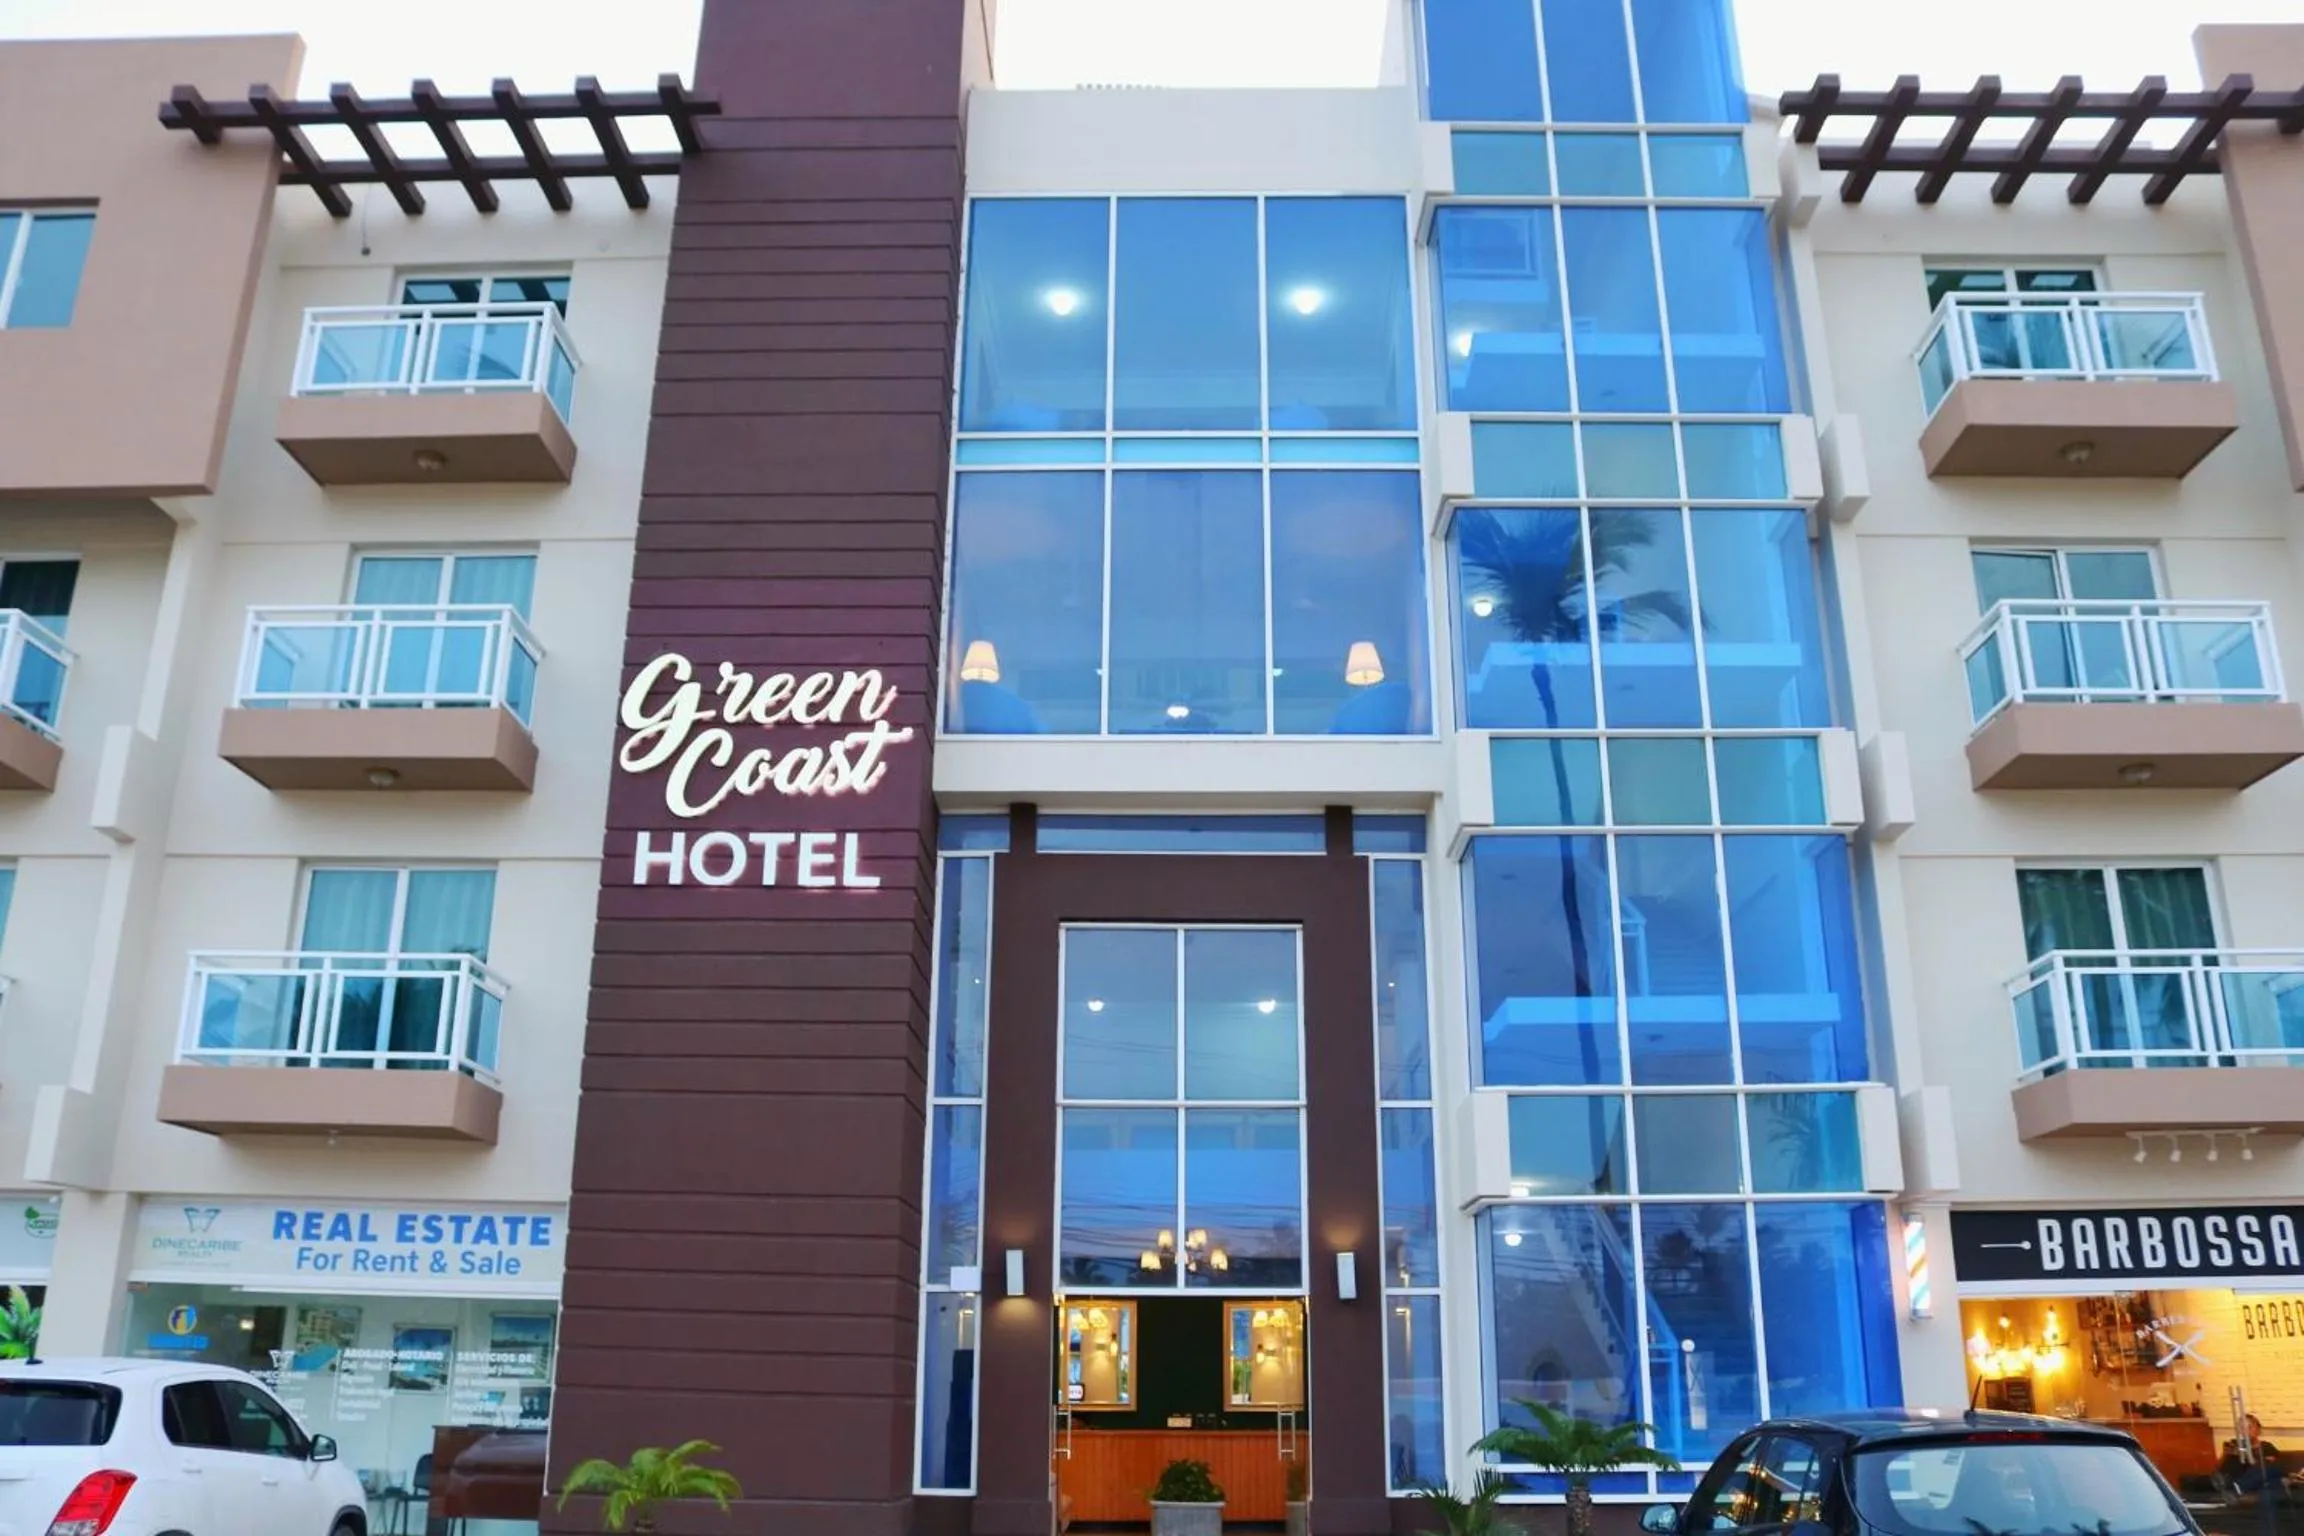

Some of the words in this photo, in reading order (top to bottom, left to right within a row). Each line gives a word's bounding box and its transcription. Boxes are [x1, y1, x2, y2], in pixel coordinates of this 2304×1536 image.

[619, 652, 899, 773] Green
[665, 719, 914, 818] Coast
[633, 830, 881, 888] HOTEL
[151, 1237, 243, 1252] DINECARIBE
[272, 1210, 378, 1243] REAL
[395, 1213, 552, 1247] ESTATE
[2037, 1214, 2301, 1271] BARBOSSA
[296, 1247, 342, 1271] For
[352, 1248, 419, 1274] Rent
[429, 1250, 448, 1274] &
[459, 1250, 522, 1276] Sale
